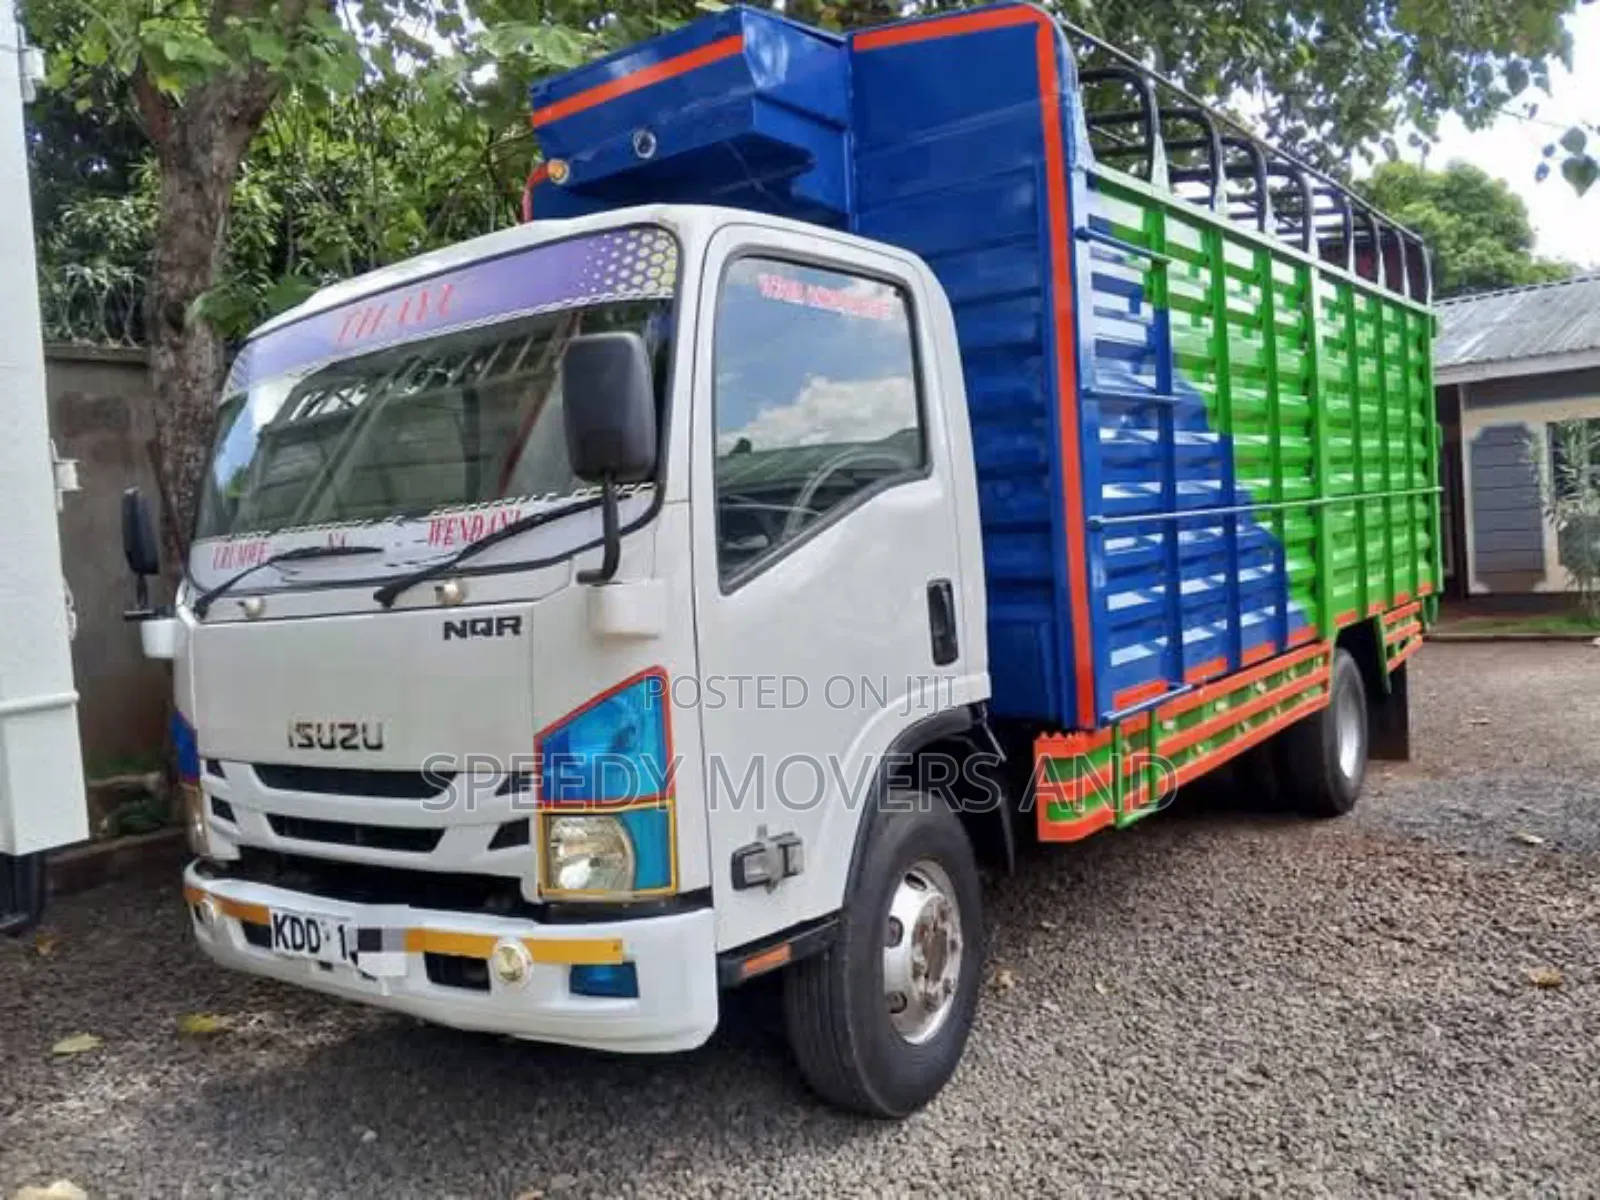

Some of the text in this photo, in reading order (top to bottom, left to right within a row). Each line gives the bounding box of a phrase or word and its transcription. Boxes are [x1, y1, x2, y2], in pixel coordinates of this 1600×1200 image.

[443, 615, 522, 640] NQR
[288, 721, 384, 751] ISUZU
[272, 913, 321, 954] KDD
